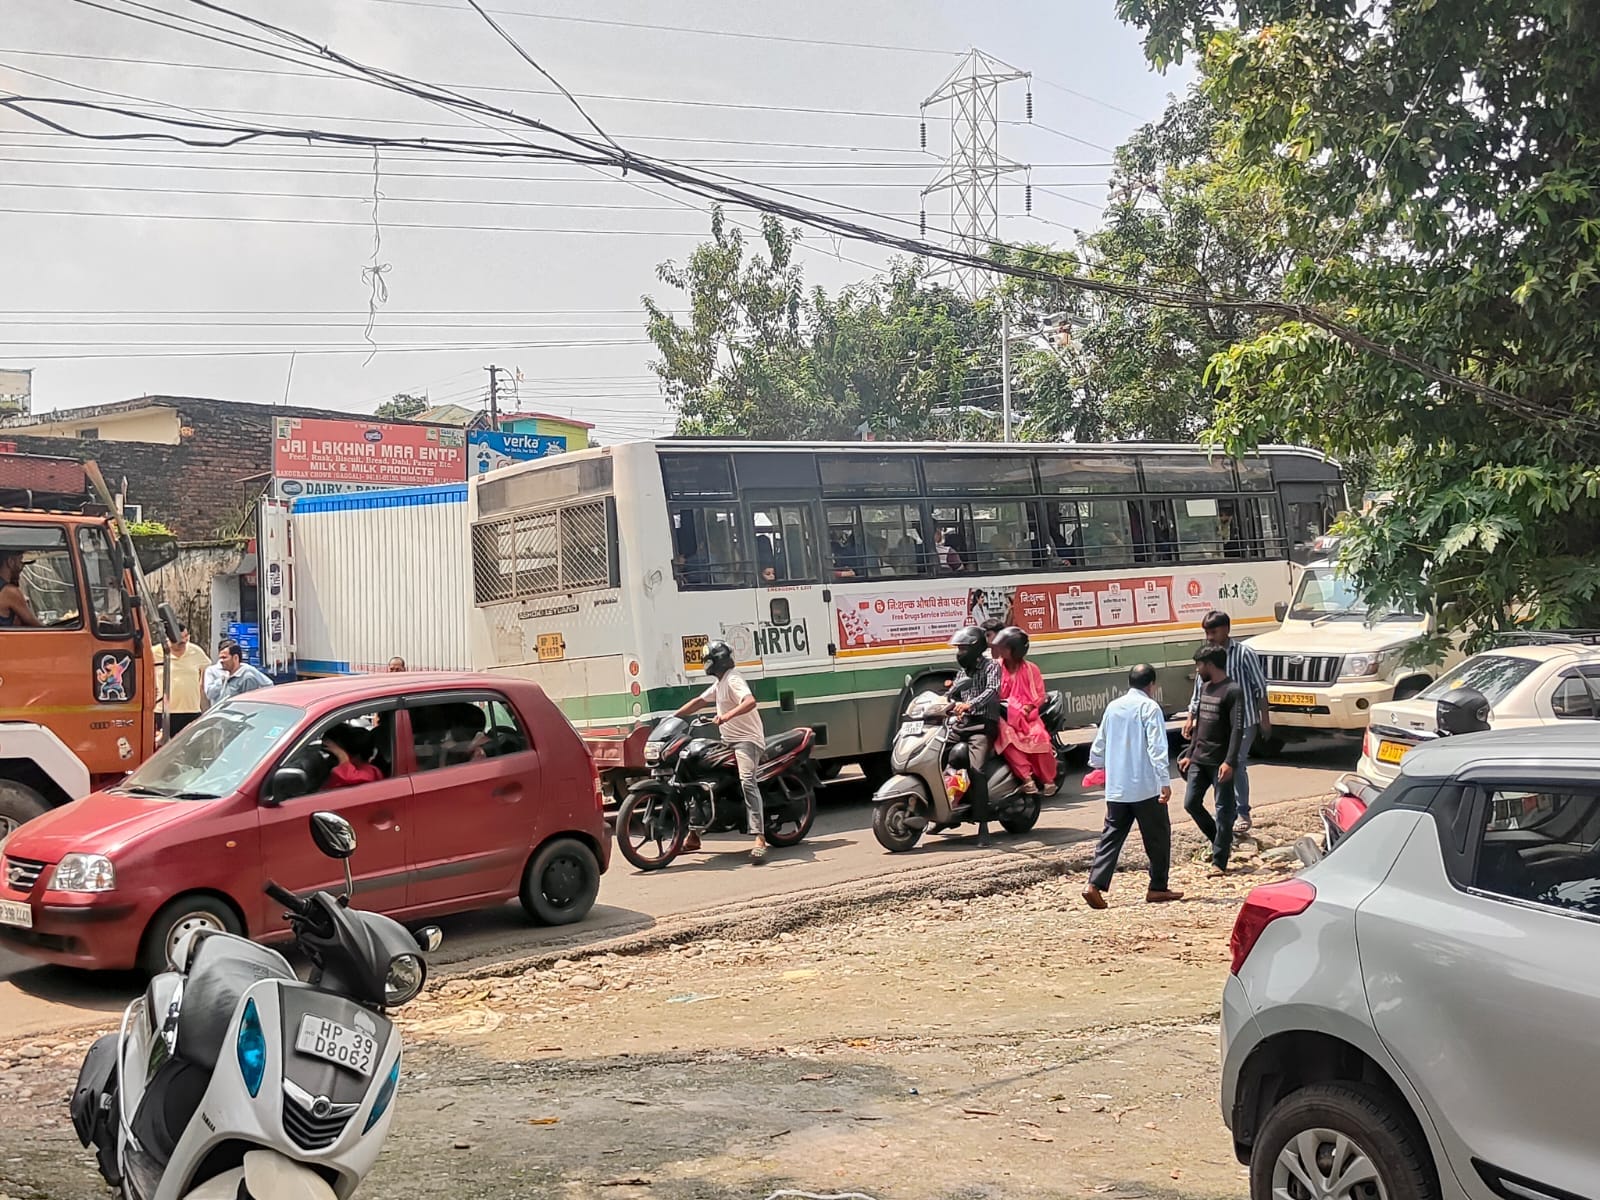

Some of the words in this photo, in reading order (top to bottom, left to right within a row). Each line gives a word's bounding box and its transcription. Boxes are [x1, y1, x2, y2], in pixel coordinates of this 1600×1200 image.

[281, 440, 307, 454] JAI
[312, 441, 375, 457] LAKHNA
[381, 445, 414, 459] MAA
[420, 447, 461, 463] ENTP.
[503, 435, 539, 449] verka
[310, 462, 336, 472] MILK
[340, 464, 348, 472] &
[352, 464, 376, 473] MILK
[380, 465, 434, 476] PRODUCTS
[306, 482, 342, 494] DAIRY
[753, 624, 806, 656] HRTC
[1065, 688, 1109, 716] Transport
[320, 1022, 342, 1040] HP
[352, 1034, 373, 1054] 39
[315, 1036, 369, 1072] D8062
